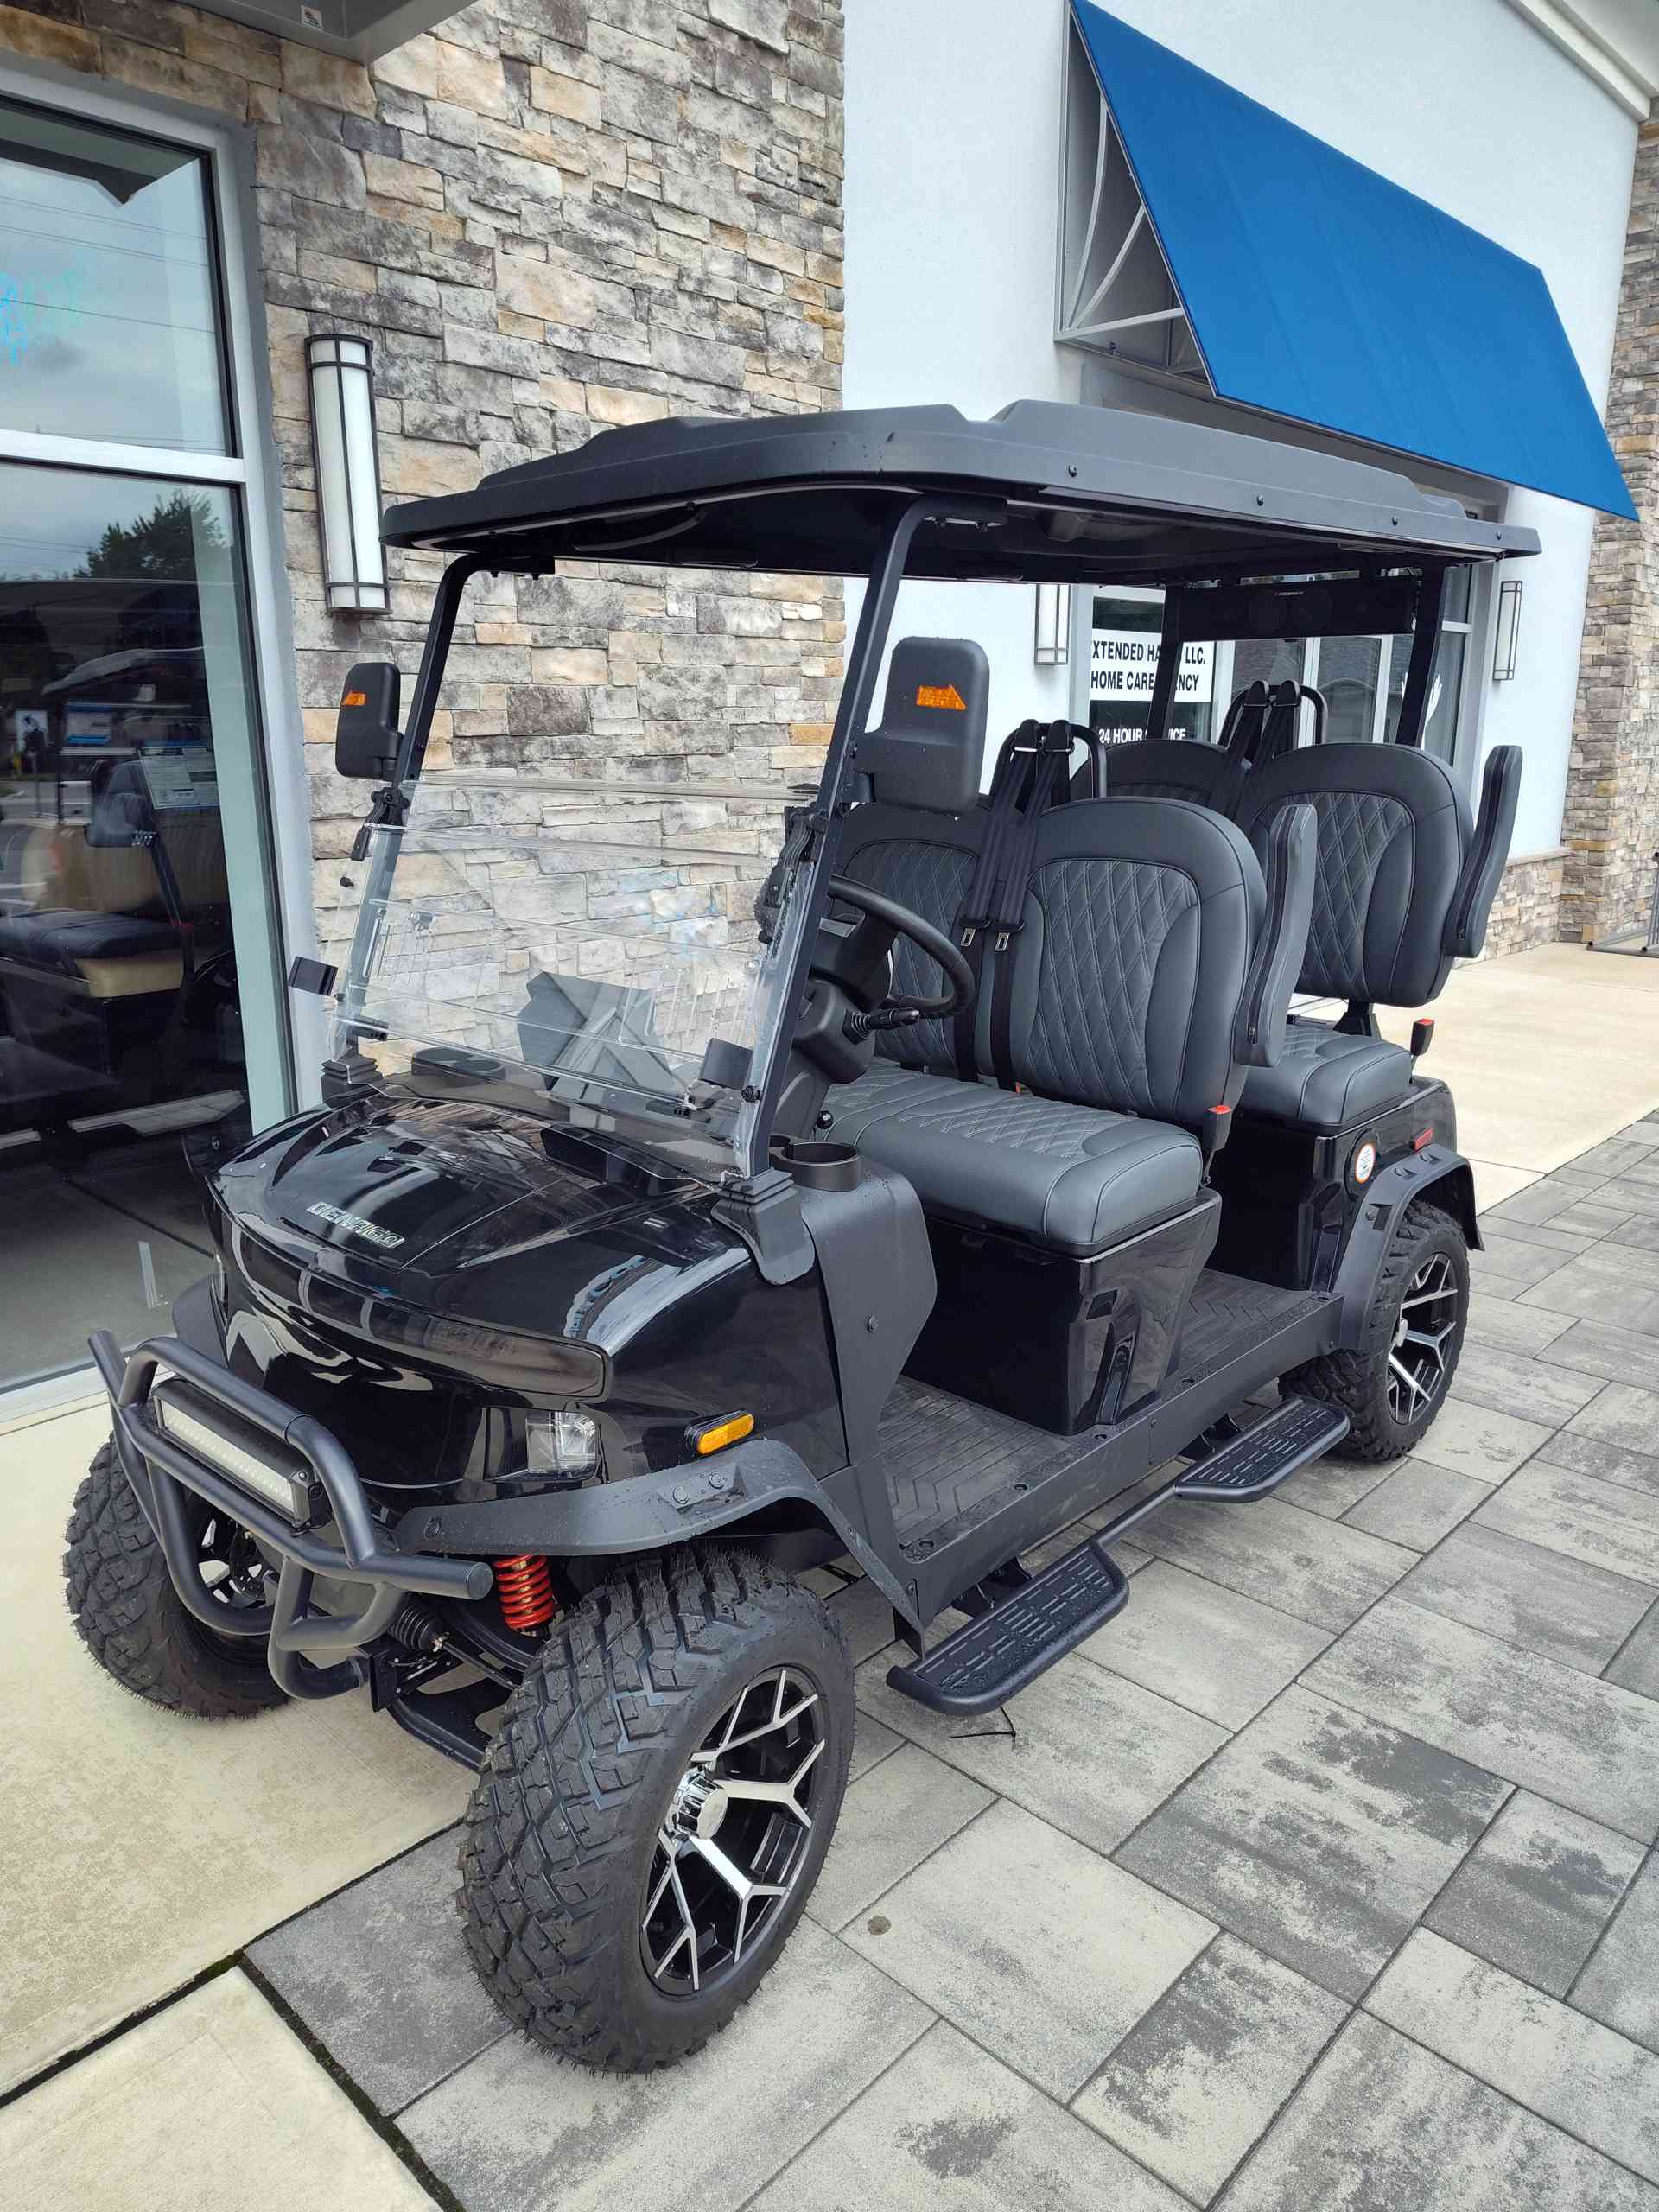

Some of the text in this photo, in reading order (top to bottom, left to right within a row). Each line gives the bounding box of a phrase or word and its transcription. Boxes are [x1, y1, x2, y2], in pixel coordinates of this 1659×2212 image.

[1185, 646, 1206, 664] LLC.
[1090, 670, 1199, 692] HOME CARE NCY
[1098, 728, 1111, 744] 24
[1112, 728, 1143, 743] HOUR
[306, 1202, 405, 1249] DENAGO
